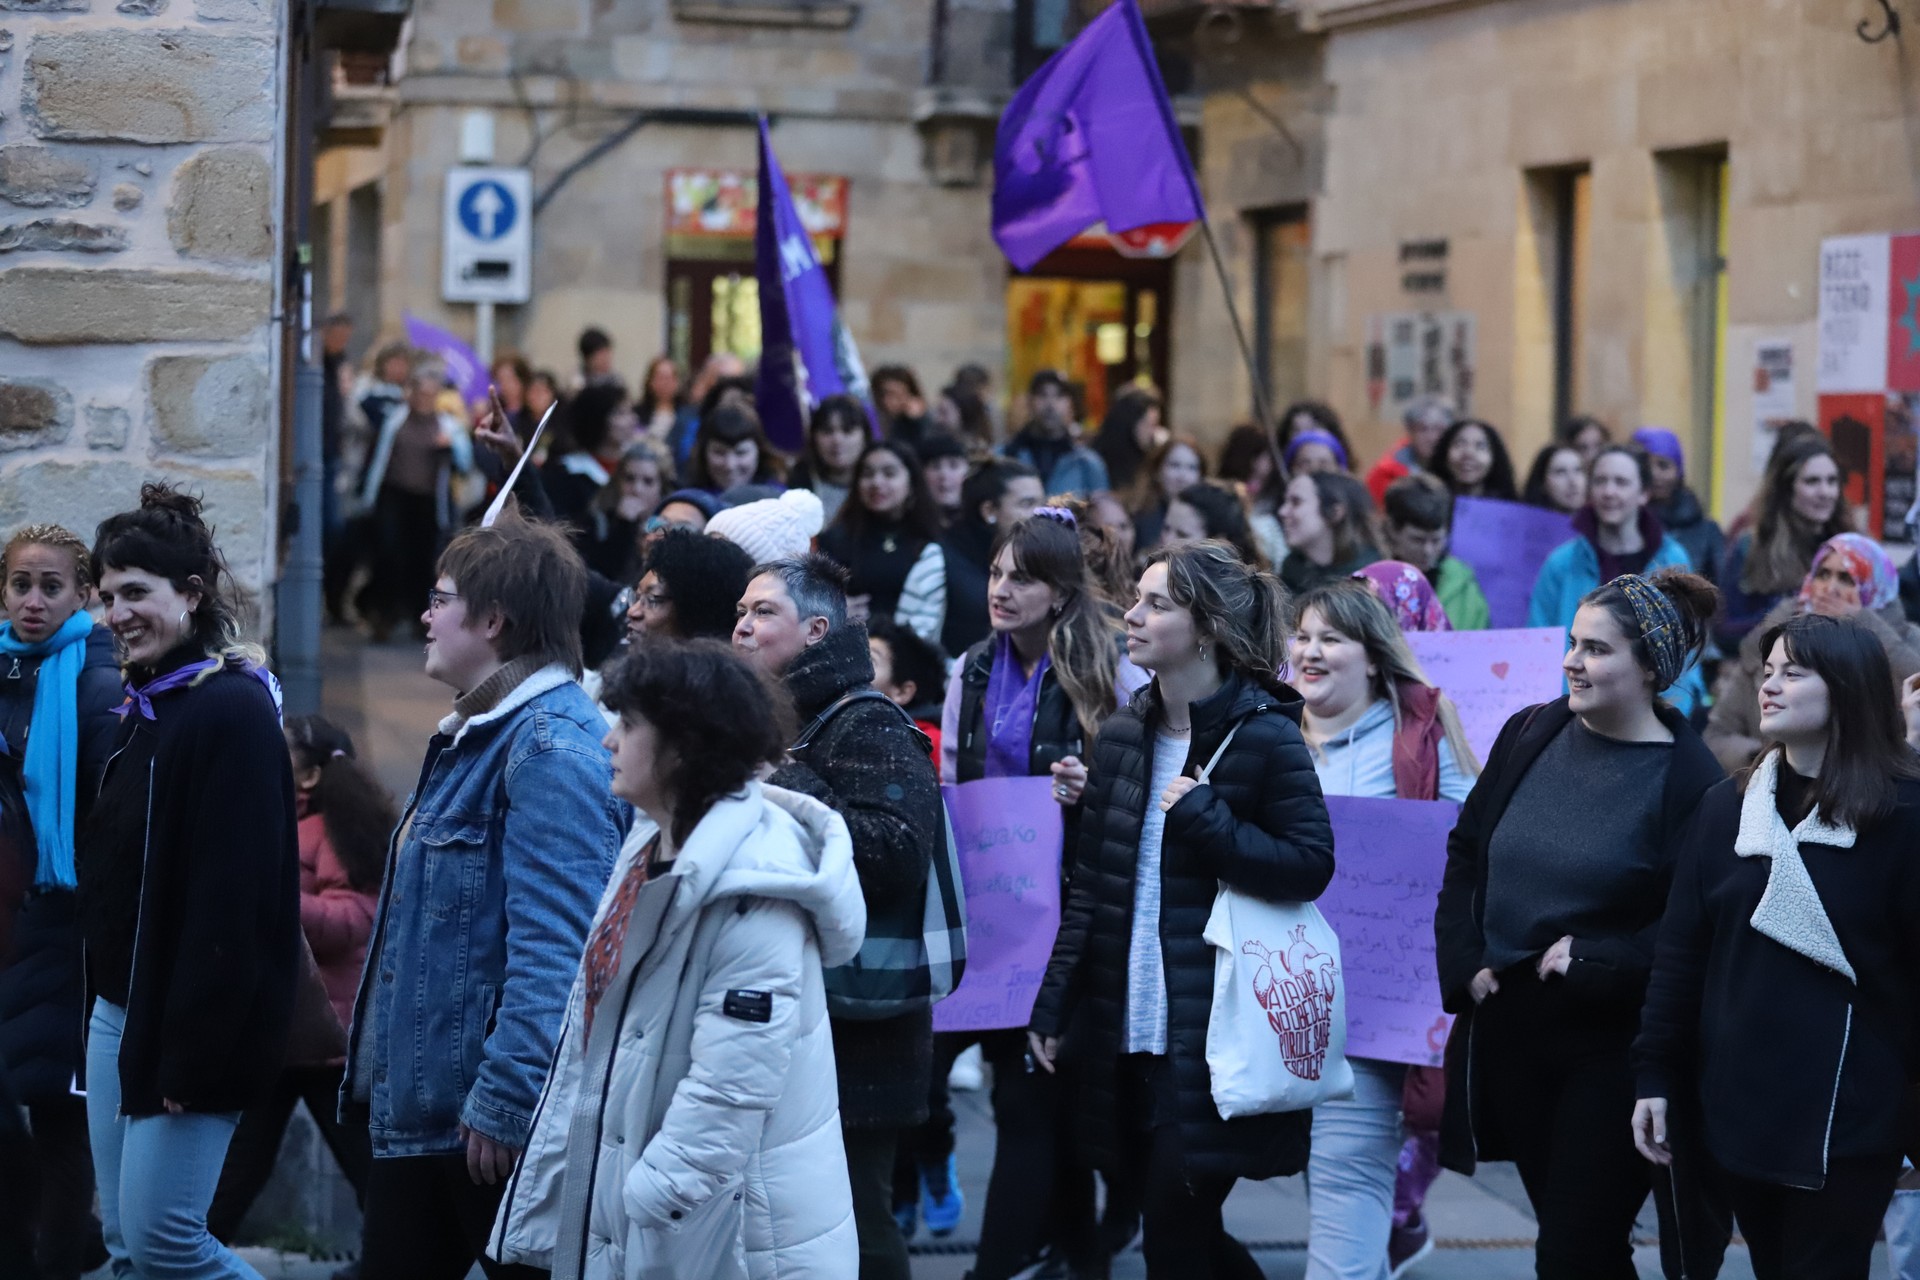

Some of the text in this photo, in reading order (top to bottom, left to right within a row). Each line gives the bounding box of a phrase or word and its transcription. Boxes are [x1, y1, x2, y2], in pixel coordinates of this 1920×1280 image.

[1269, 984, 1281, 1010] A
[1280, 981, 1301, 1009] LA
[1294, 969, 1319, 999] QUE
[1267, 1011, 1291, 1035] NO
[1290, 993, 1332, 1031] OBEDECE
[1279, 1028, 1312, 1060] PORQUE
[1314, 1021, 1330, 1053] SABE
[1284, 1050, 1326, 1082] ESCOGER
